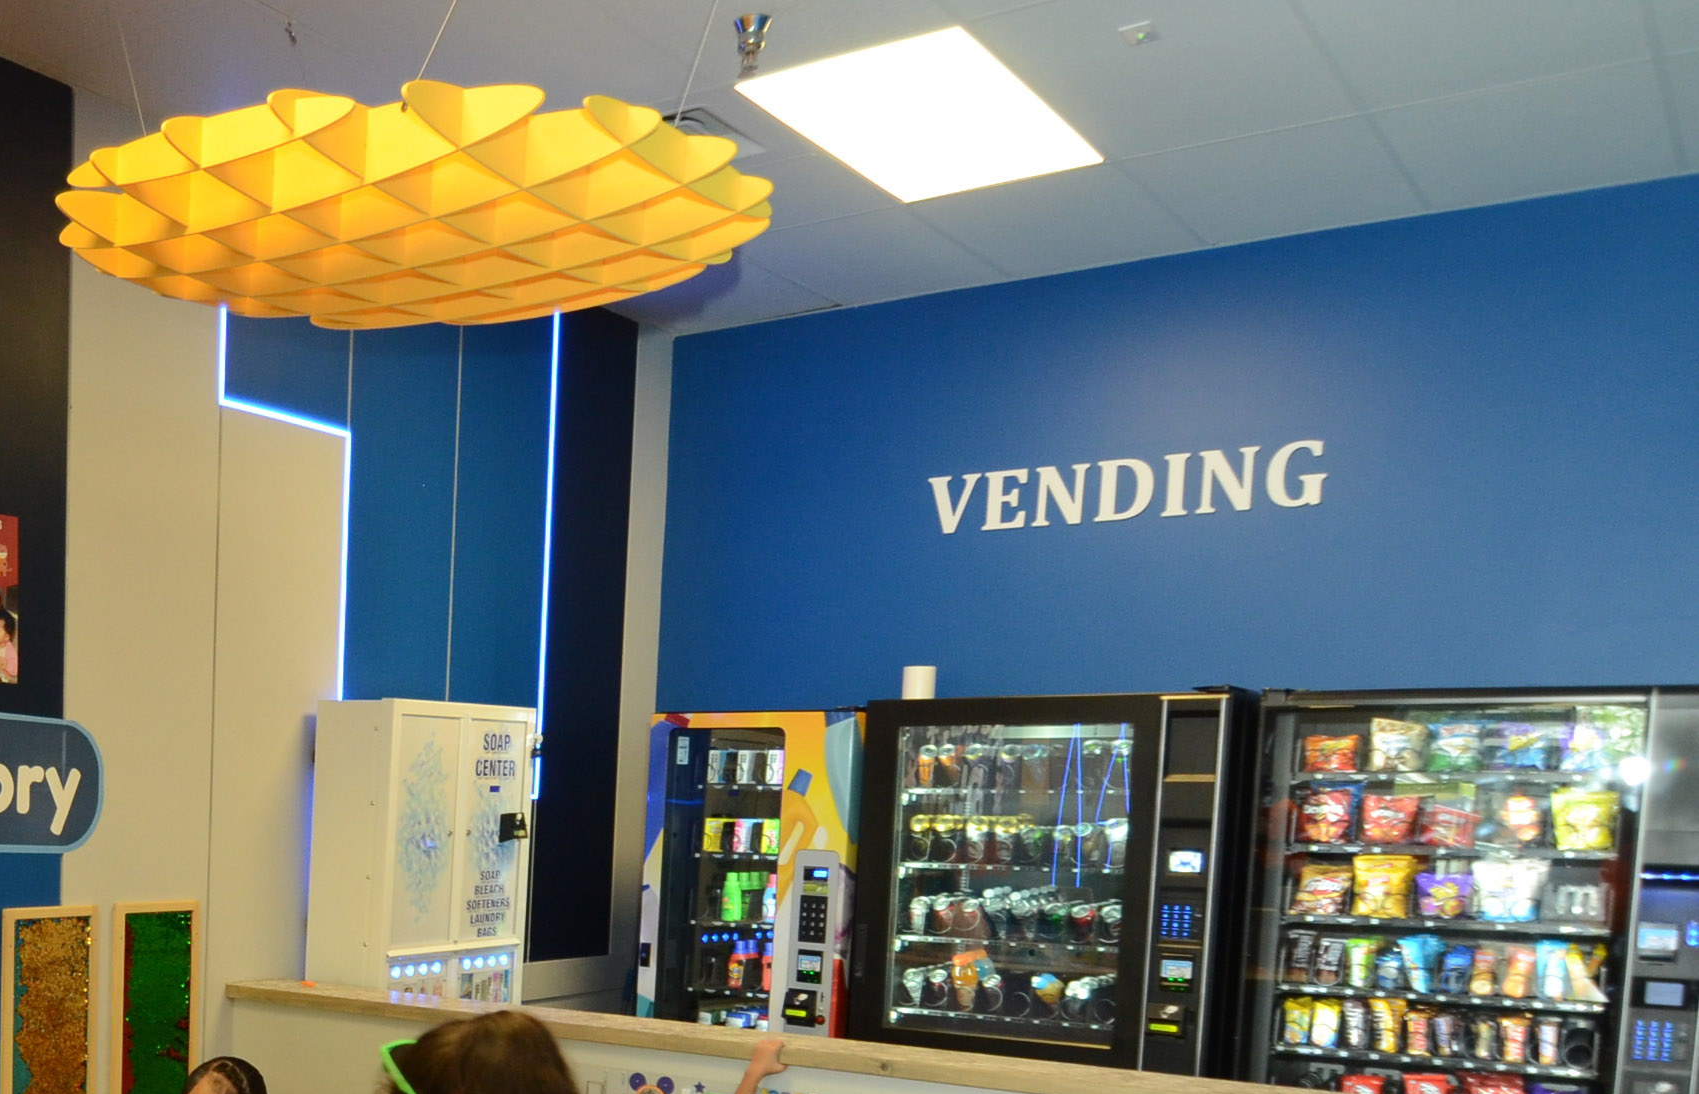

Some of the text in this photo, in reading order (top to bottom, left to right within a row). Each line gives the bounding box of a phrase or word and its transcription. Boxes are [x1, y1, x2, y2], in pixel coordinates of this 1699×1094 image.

[928, 439, 1329, 535] VENDING
[483, 733, 512, 751] SOAP
[475, 759, 516, 777] CENTER
[480, 870, 501, 881] SOAP
[474, 884, 505, 896] BLEACH
[466, 897, 510, 910] SOFTENERS
[470, 912, 506, 924] LAUNDRY
[477, 926, 498, 938] BAGS
